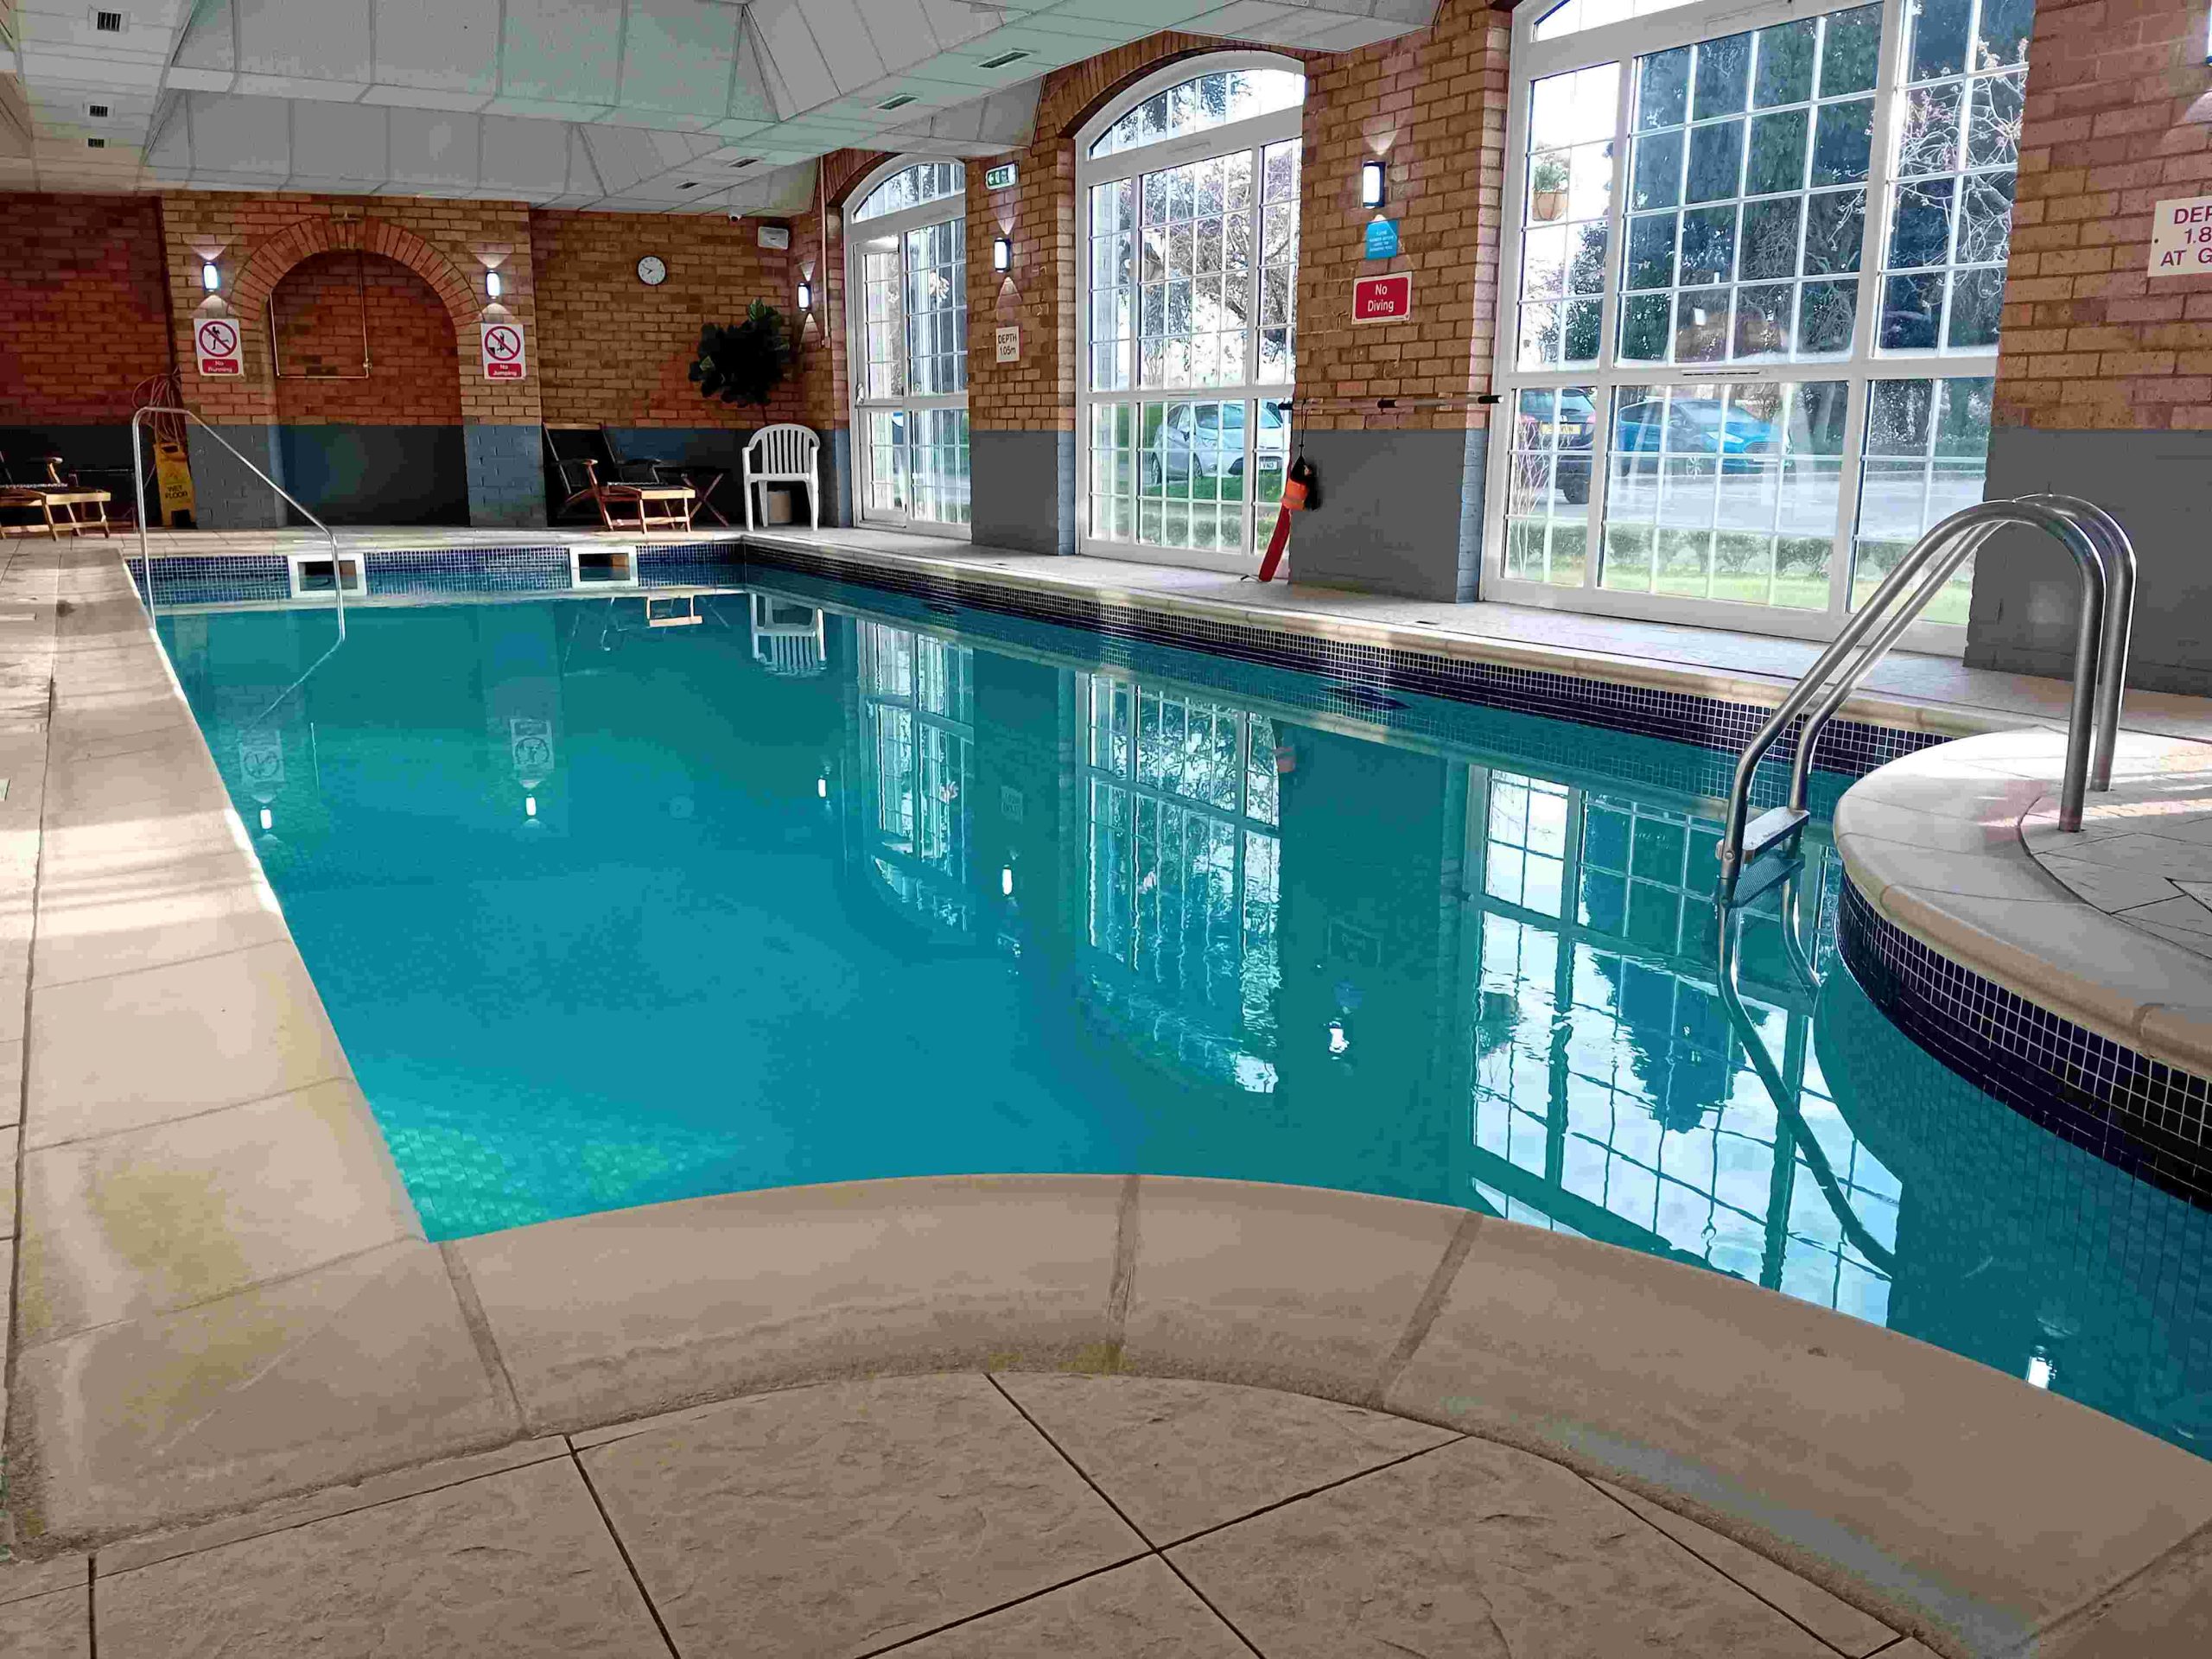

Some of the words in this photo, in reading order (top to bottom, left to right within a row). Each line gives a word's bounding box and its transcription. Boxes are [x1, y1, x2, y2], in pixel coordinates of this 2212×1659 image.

[2160, 250, 2188, 267] AT
[1375, 283, 1389, 296] No
[1367, 299, 1395, 313] Diving
[997, 333, 1018, 344] DEPTH
